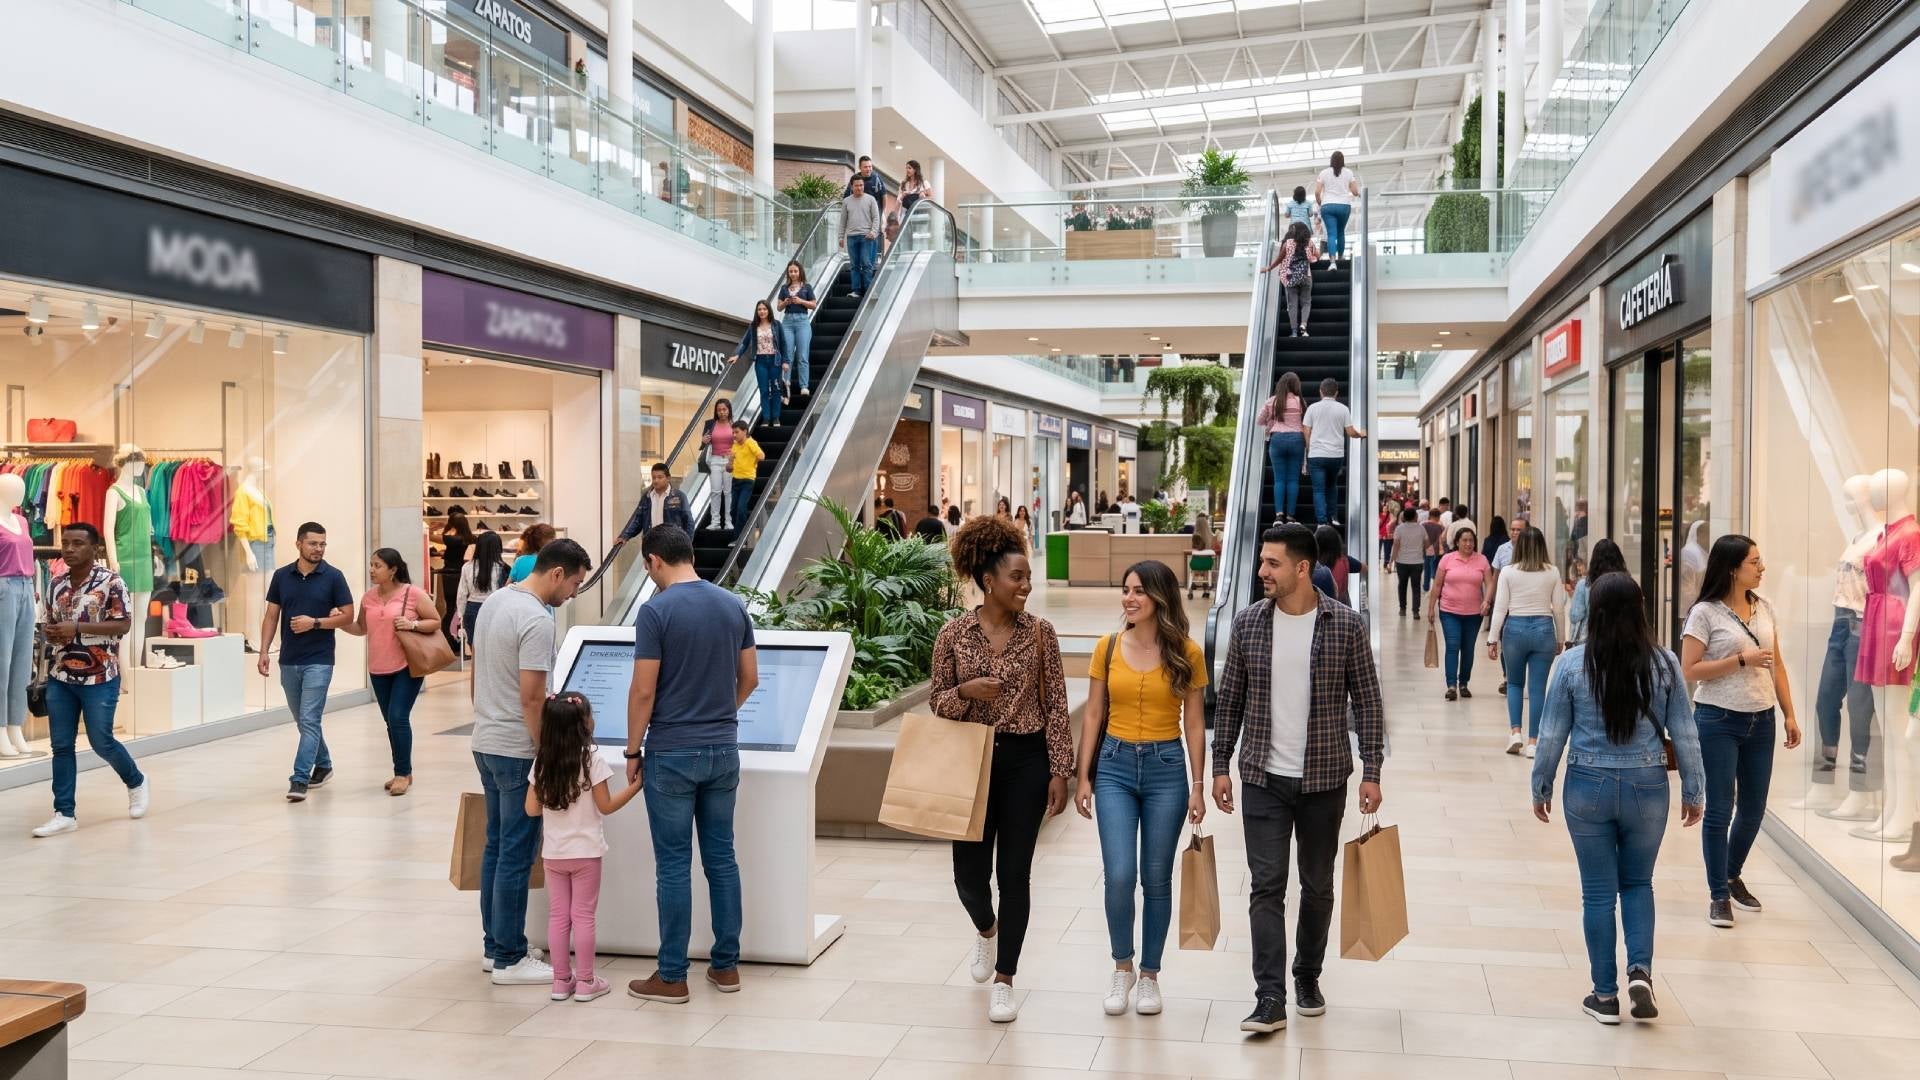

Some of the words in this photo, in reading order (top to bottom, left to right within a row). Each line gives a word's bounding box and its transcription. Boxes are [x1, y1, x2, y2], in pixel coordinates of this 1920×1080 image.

[474, 0, 532, 44] ZAPATOS
[1620, 253, 1673, 330] CAFETERÍA
[672, 342, 726, 375] ZAPATOS
